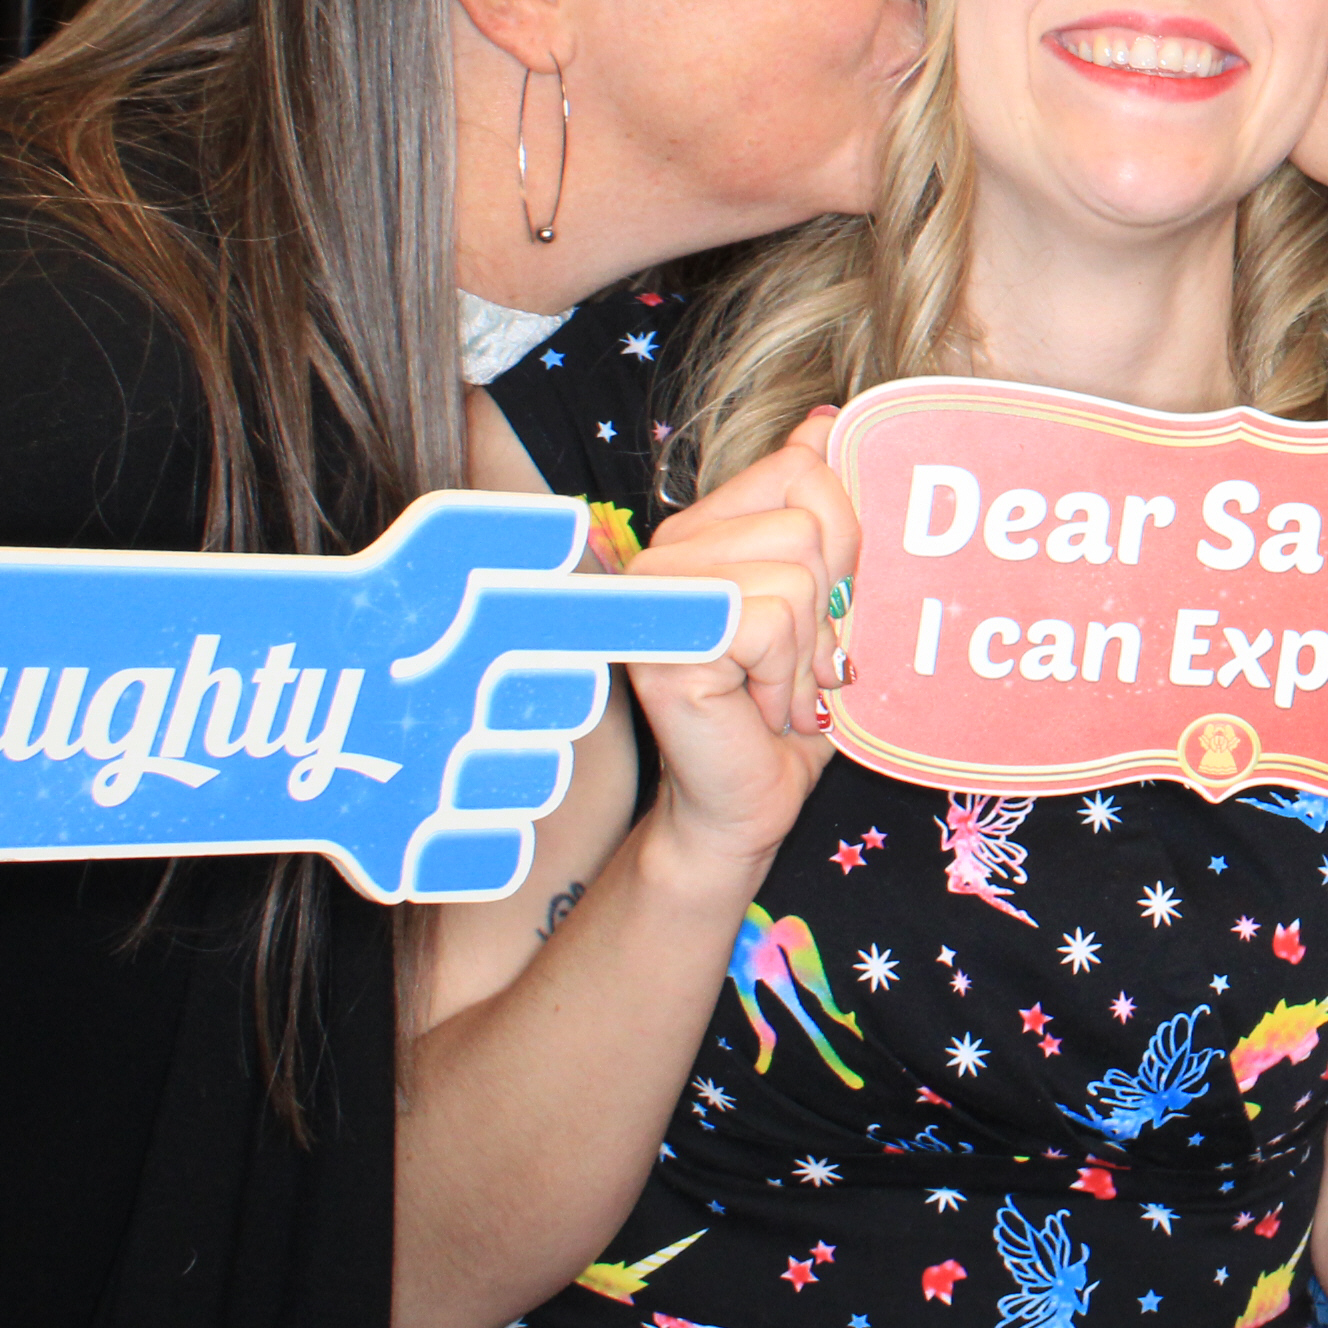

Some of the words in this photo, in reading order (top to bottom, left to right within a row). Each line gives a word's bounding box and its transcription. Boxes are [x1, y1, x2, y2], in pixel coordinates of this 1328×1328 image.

[902, 464, 1175, 565] Dear
[913, 598, 943, 677] I
[968, 614, 1141, 683] can
[0, 634, 403, 807] ughty
